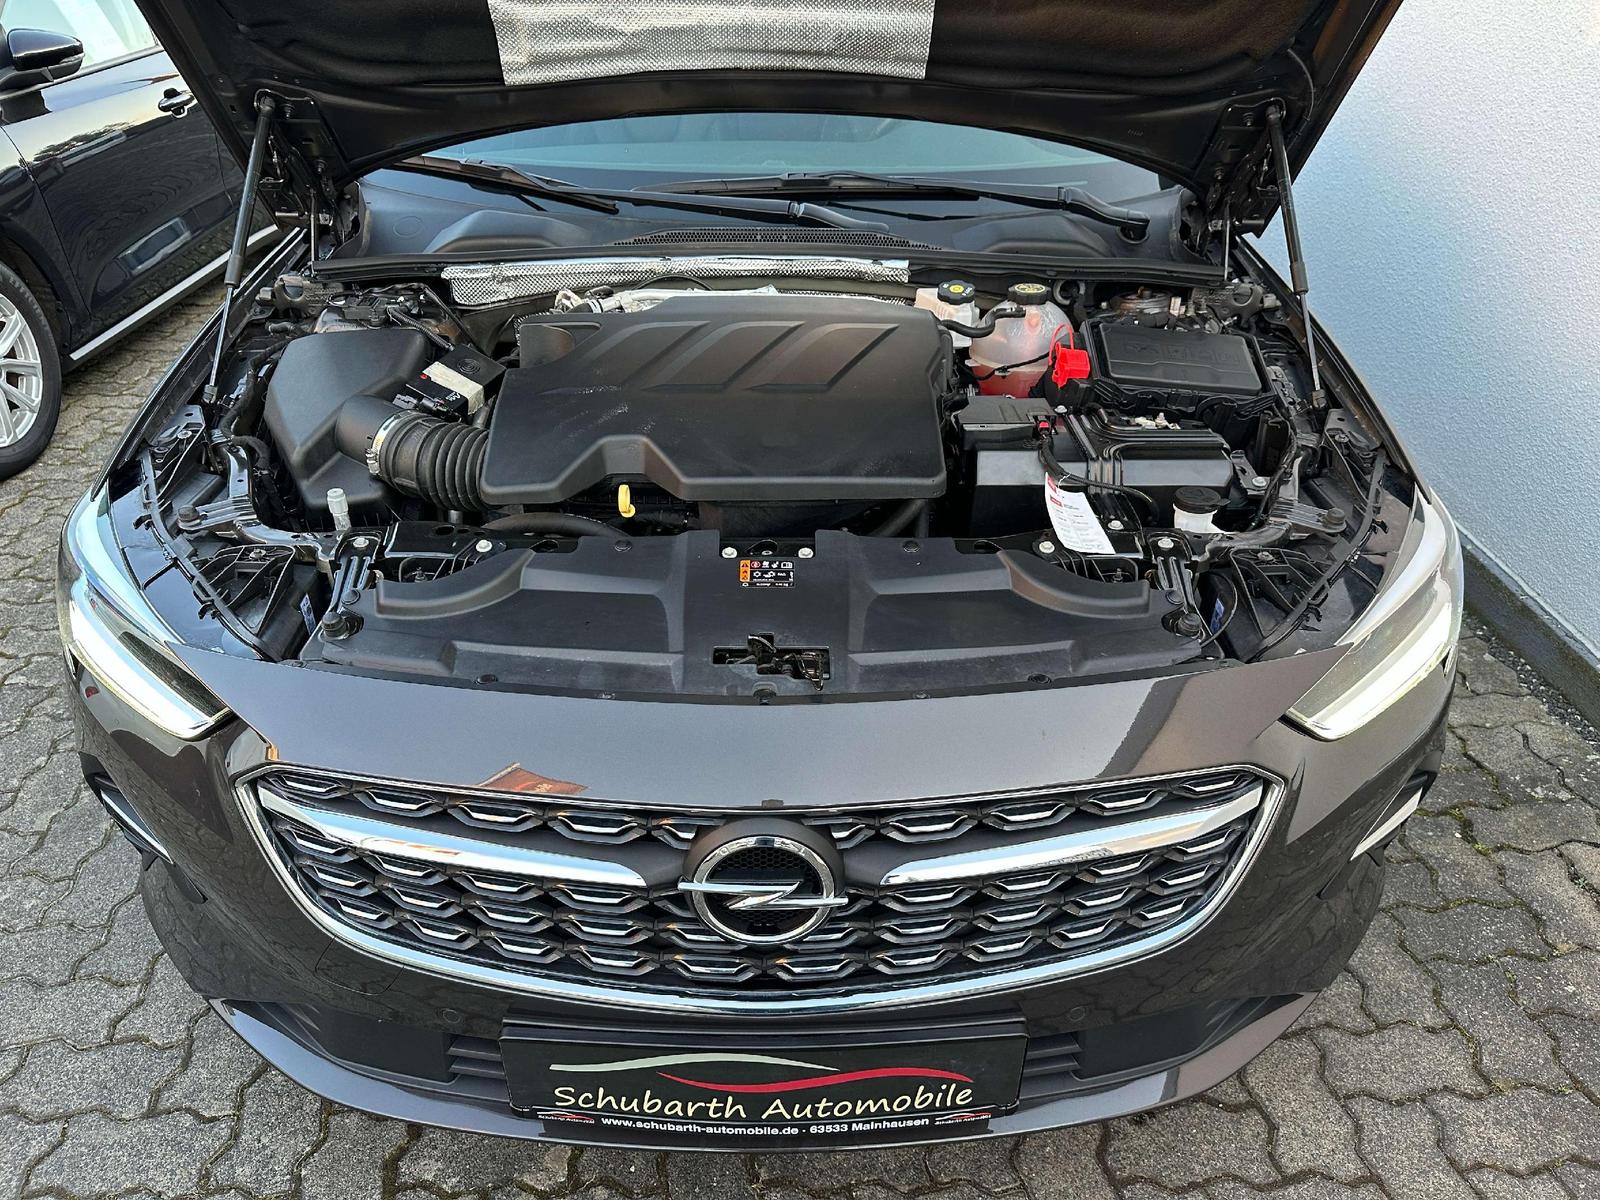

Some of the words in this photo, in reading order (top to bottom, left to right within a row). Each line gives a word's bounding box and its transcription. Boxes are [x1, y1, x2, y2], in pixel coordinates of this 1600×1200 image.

[554, 1086, 747, 1119] Schubarth
[761, 1083, 973, 1119] Automobile
[601, 1117, 799, 1135] www.schubarth-automobile.de
[809, 1124, 849, 1134] 63533
[851, 1117, 930, 1132] Mainhausen
